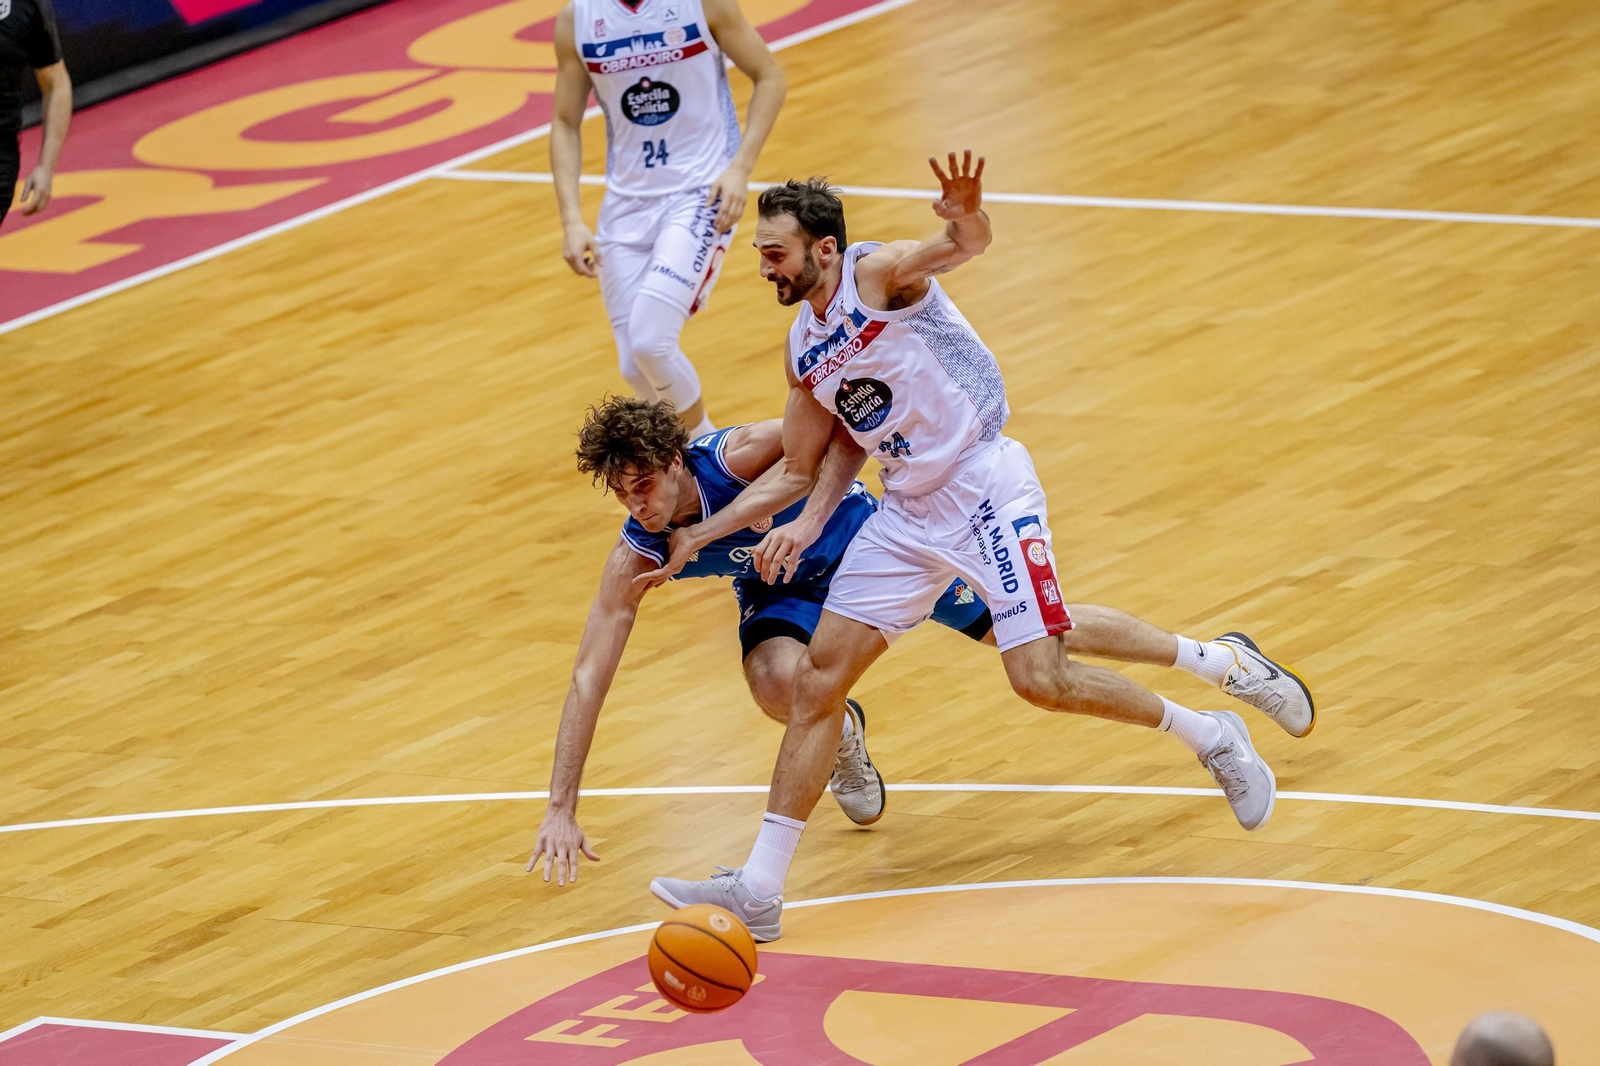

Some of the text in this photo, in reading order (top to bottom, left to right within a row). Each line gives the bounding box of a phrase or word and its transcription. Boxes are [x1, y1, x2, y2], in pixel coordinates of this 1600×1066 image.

[600, 48, 684, 74] OBRADOIRO
[626, 87, 671, 106] Estrella
[642, 138, 669, 169] 24
[810, 337, 863, 386] OBRADOIRO
[840, 384, 876, 413] Estrella
[850, 395, 884, 423] Galicia
